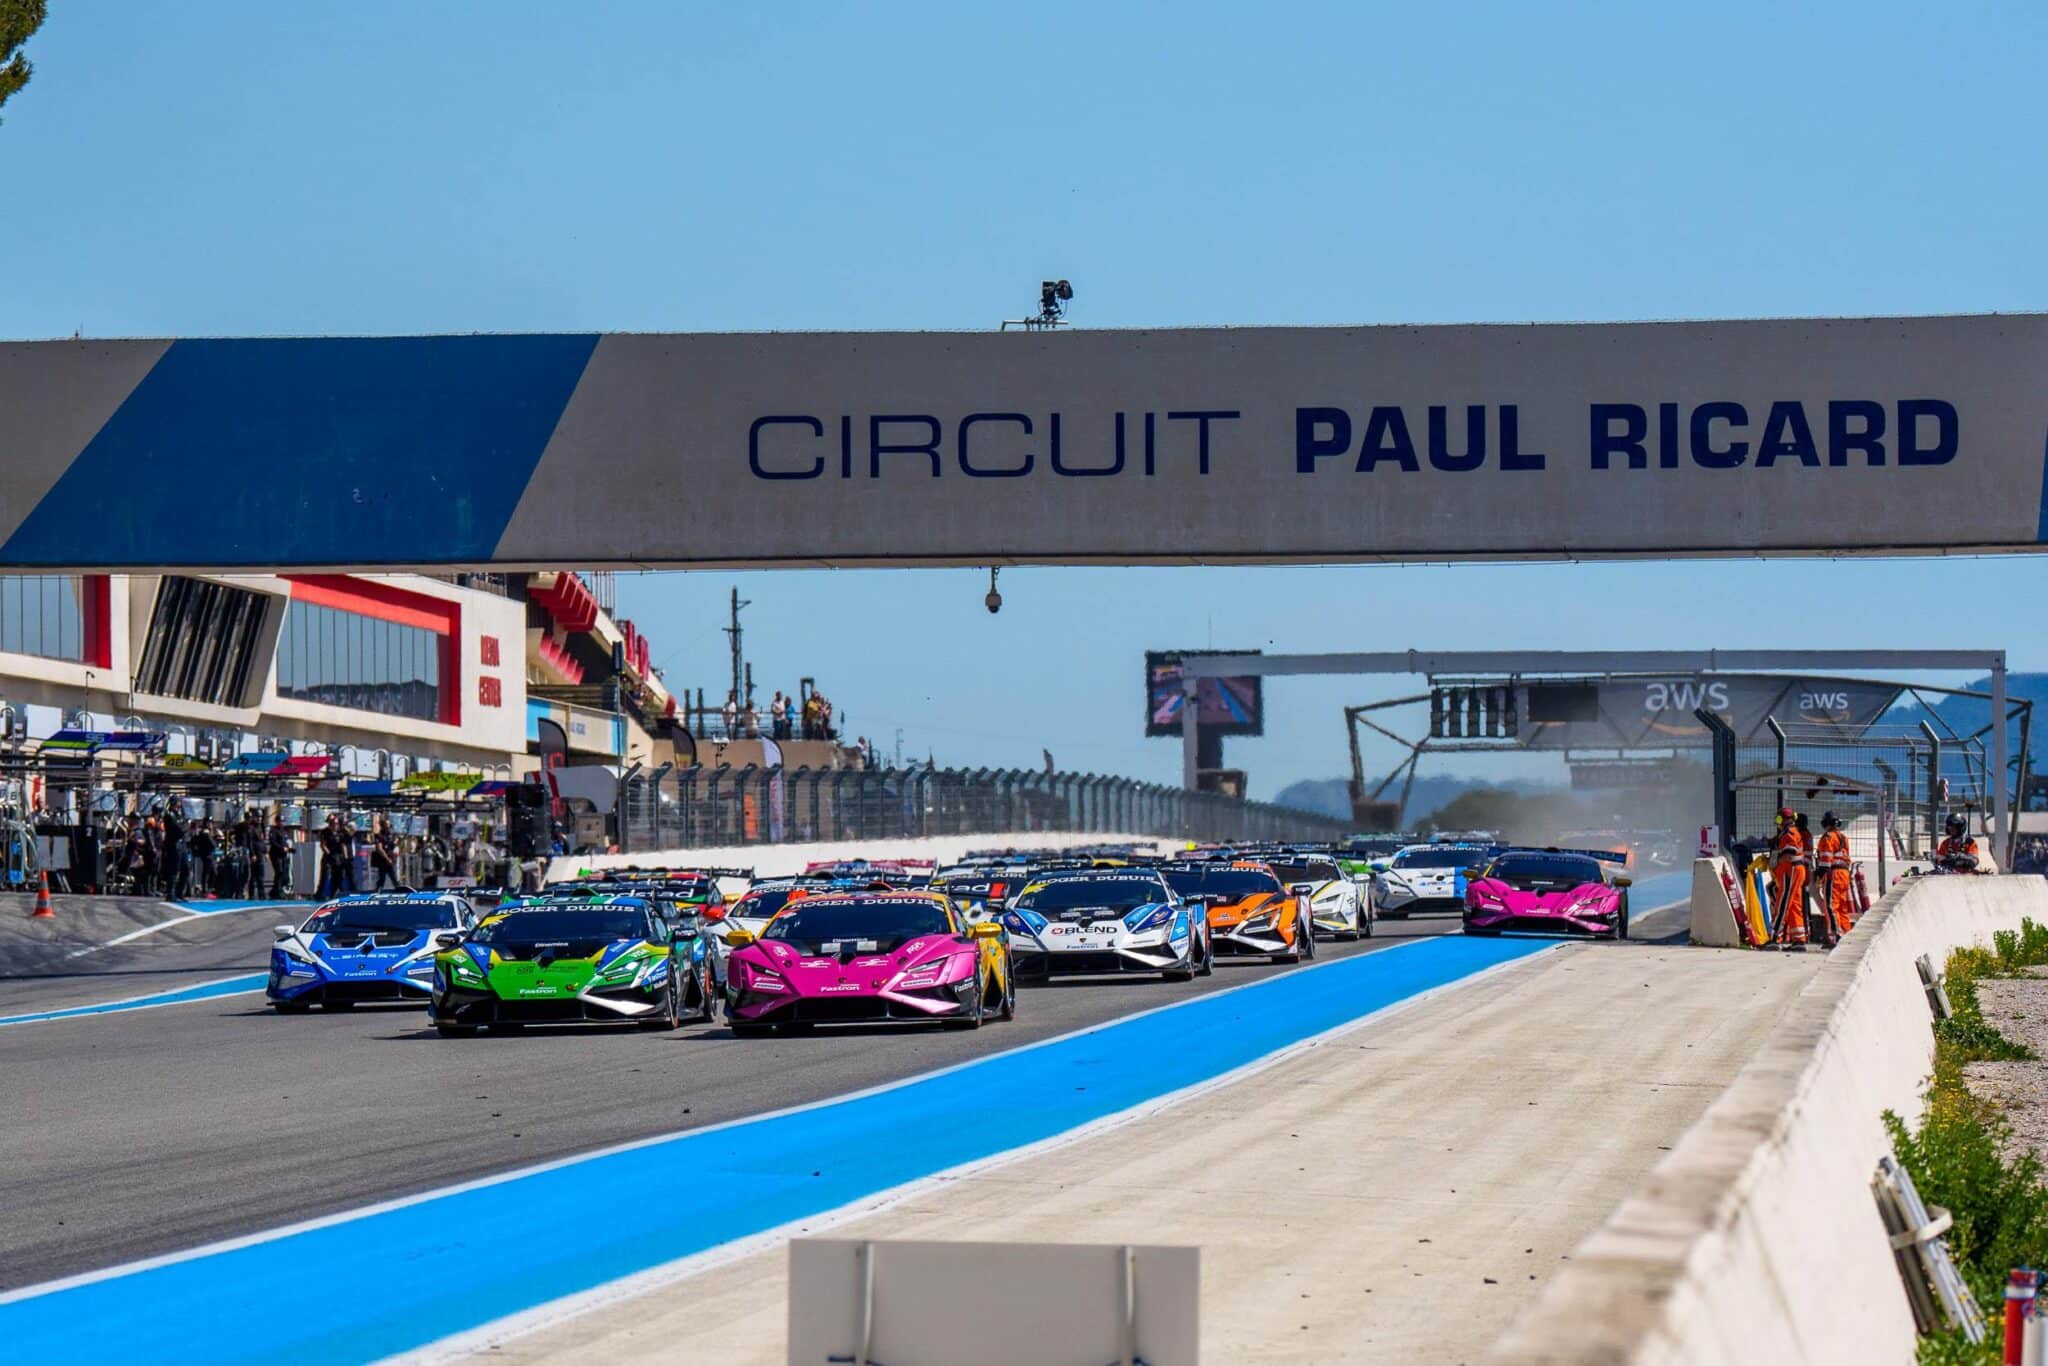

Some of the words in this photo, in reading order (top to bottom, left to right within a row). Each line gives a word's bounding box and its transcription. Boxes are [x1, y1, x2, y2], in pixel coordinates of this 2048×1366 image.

[748, 411, 1240, 480] CIRCUIT
[1296, 404, 1545, 473] PAUL
[1590, 399, 1959, 470] RICARD
[1645, 682, 1729, 711] aws
[1800, 691, 1848, 710] aws
[496, 905, 558, 915] ROGER
[565, 904, 635, 912] DUBUIS
[862, 898, 936, 906] DUBUIS
